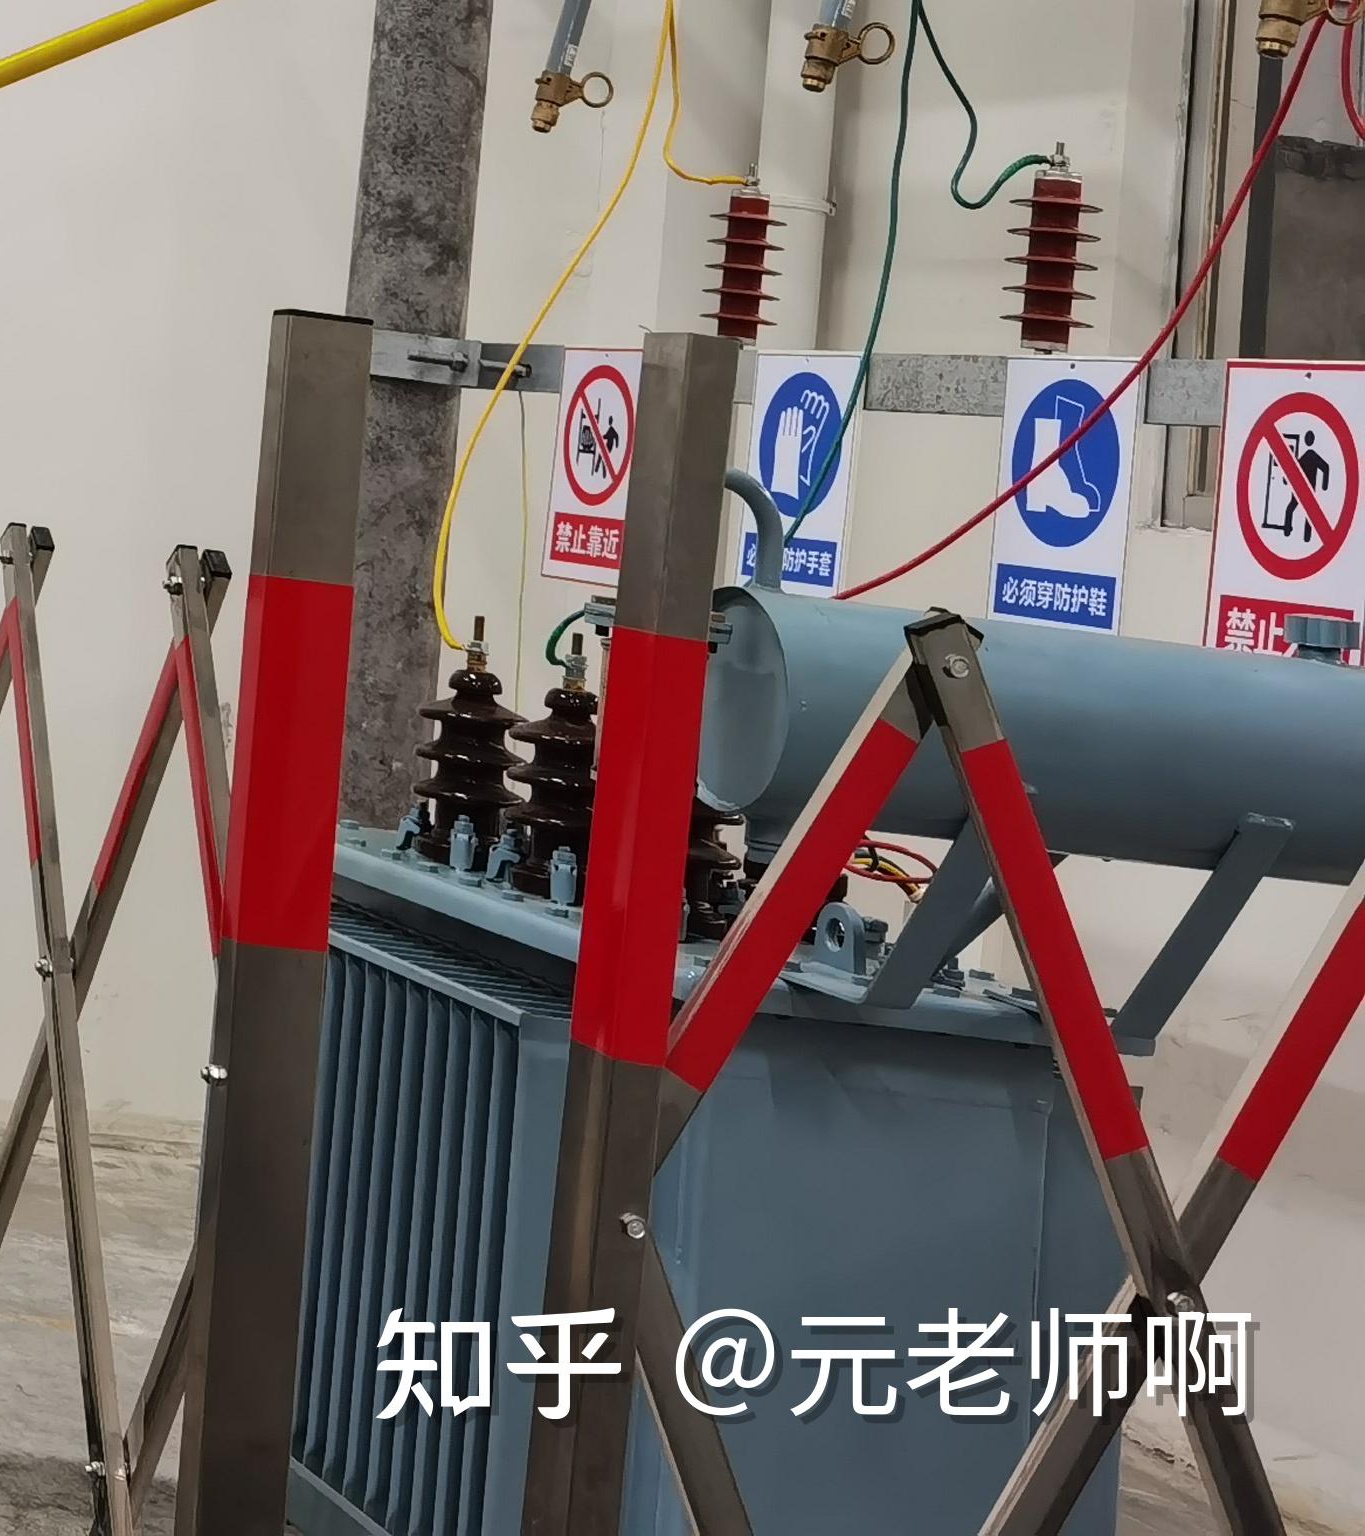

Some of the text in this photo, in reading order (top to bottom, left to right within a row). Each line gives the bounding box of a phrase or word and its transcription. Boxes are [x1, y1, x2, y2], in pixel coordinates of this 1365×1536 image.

[555, 521, 619, 560] 禁止靠近
[1002, 576, 1108, 617] 必须穿防护鞋
